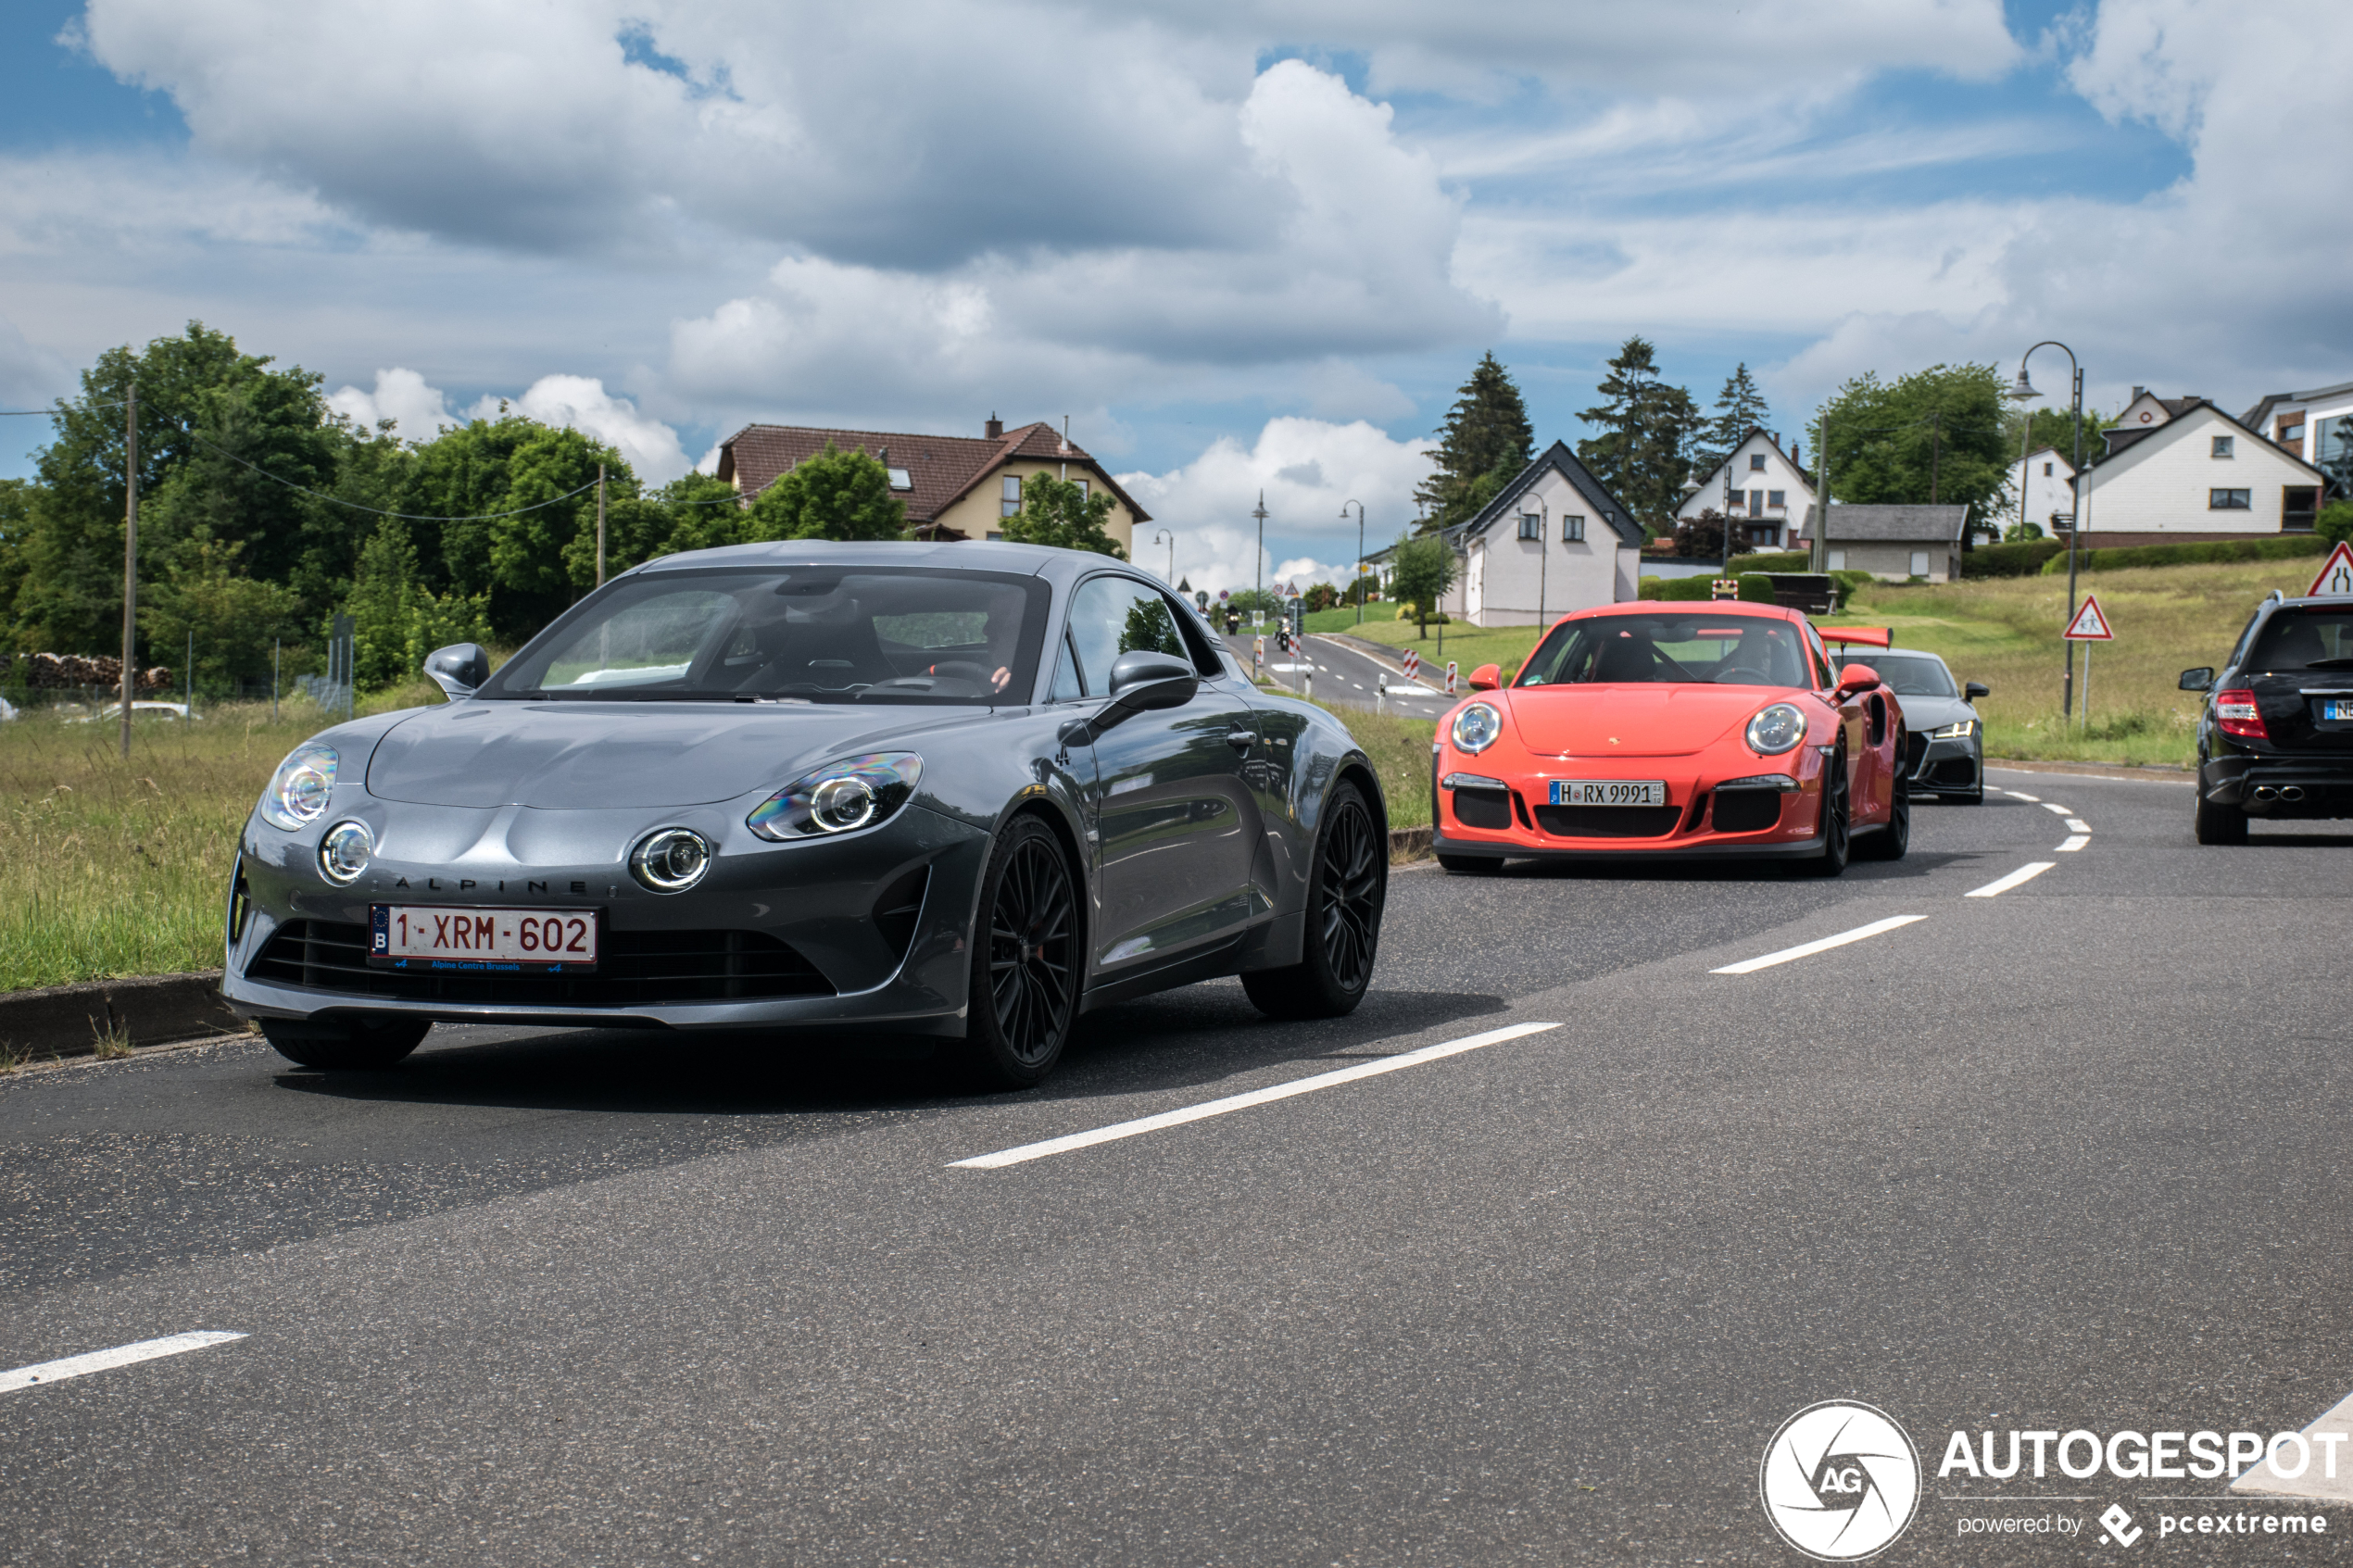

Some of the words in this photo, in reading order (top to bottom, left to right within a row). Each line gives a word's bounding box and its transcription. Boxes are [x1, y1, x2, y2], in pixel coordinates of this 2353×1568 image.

[1561, 784, 1571, 802] H
[1584, 784, 1604, 803] RX
[1610, 785, 1651, 803] 9991
[396, 876, 586, 894] ALPINE
[375, 933, 387, 948] B
[432, 960, 457, 970] Alpine
[458, 961, 484, 970] Centre
[486, 962, 521, 972] Brussels
